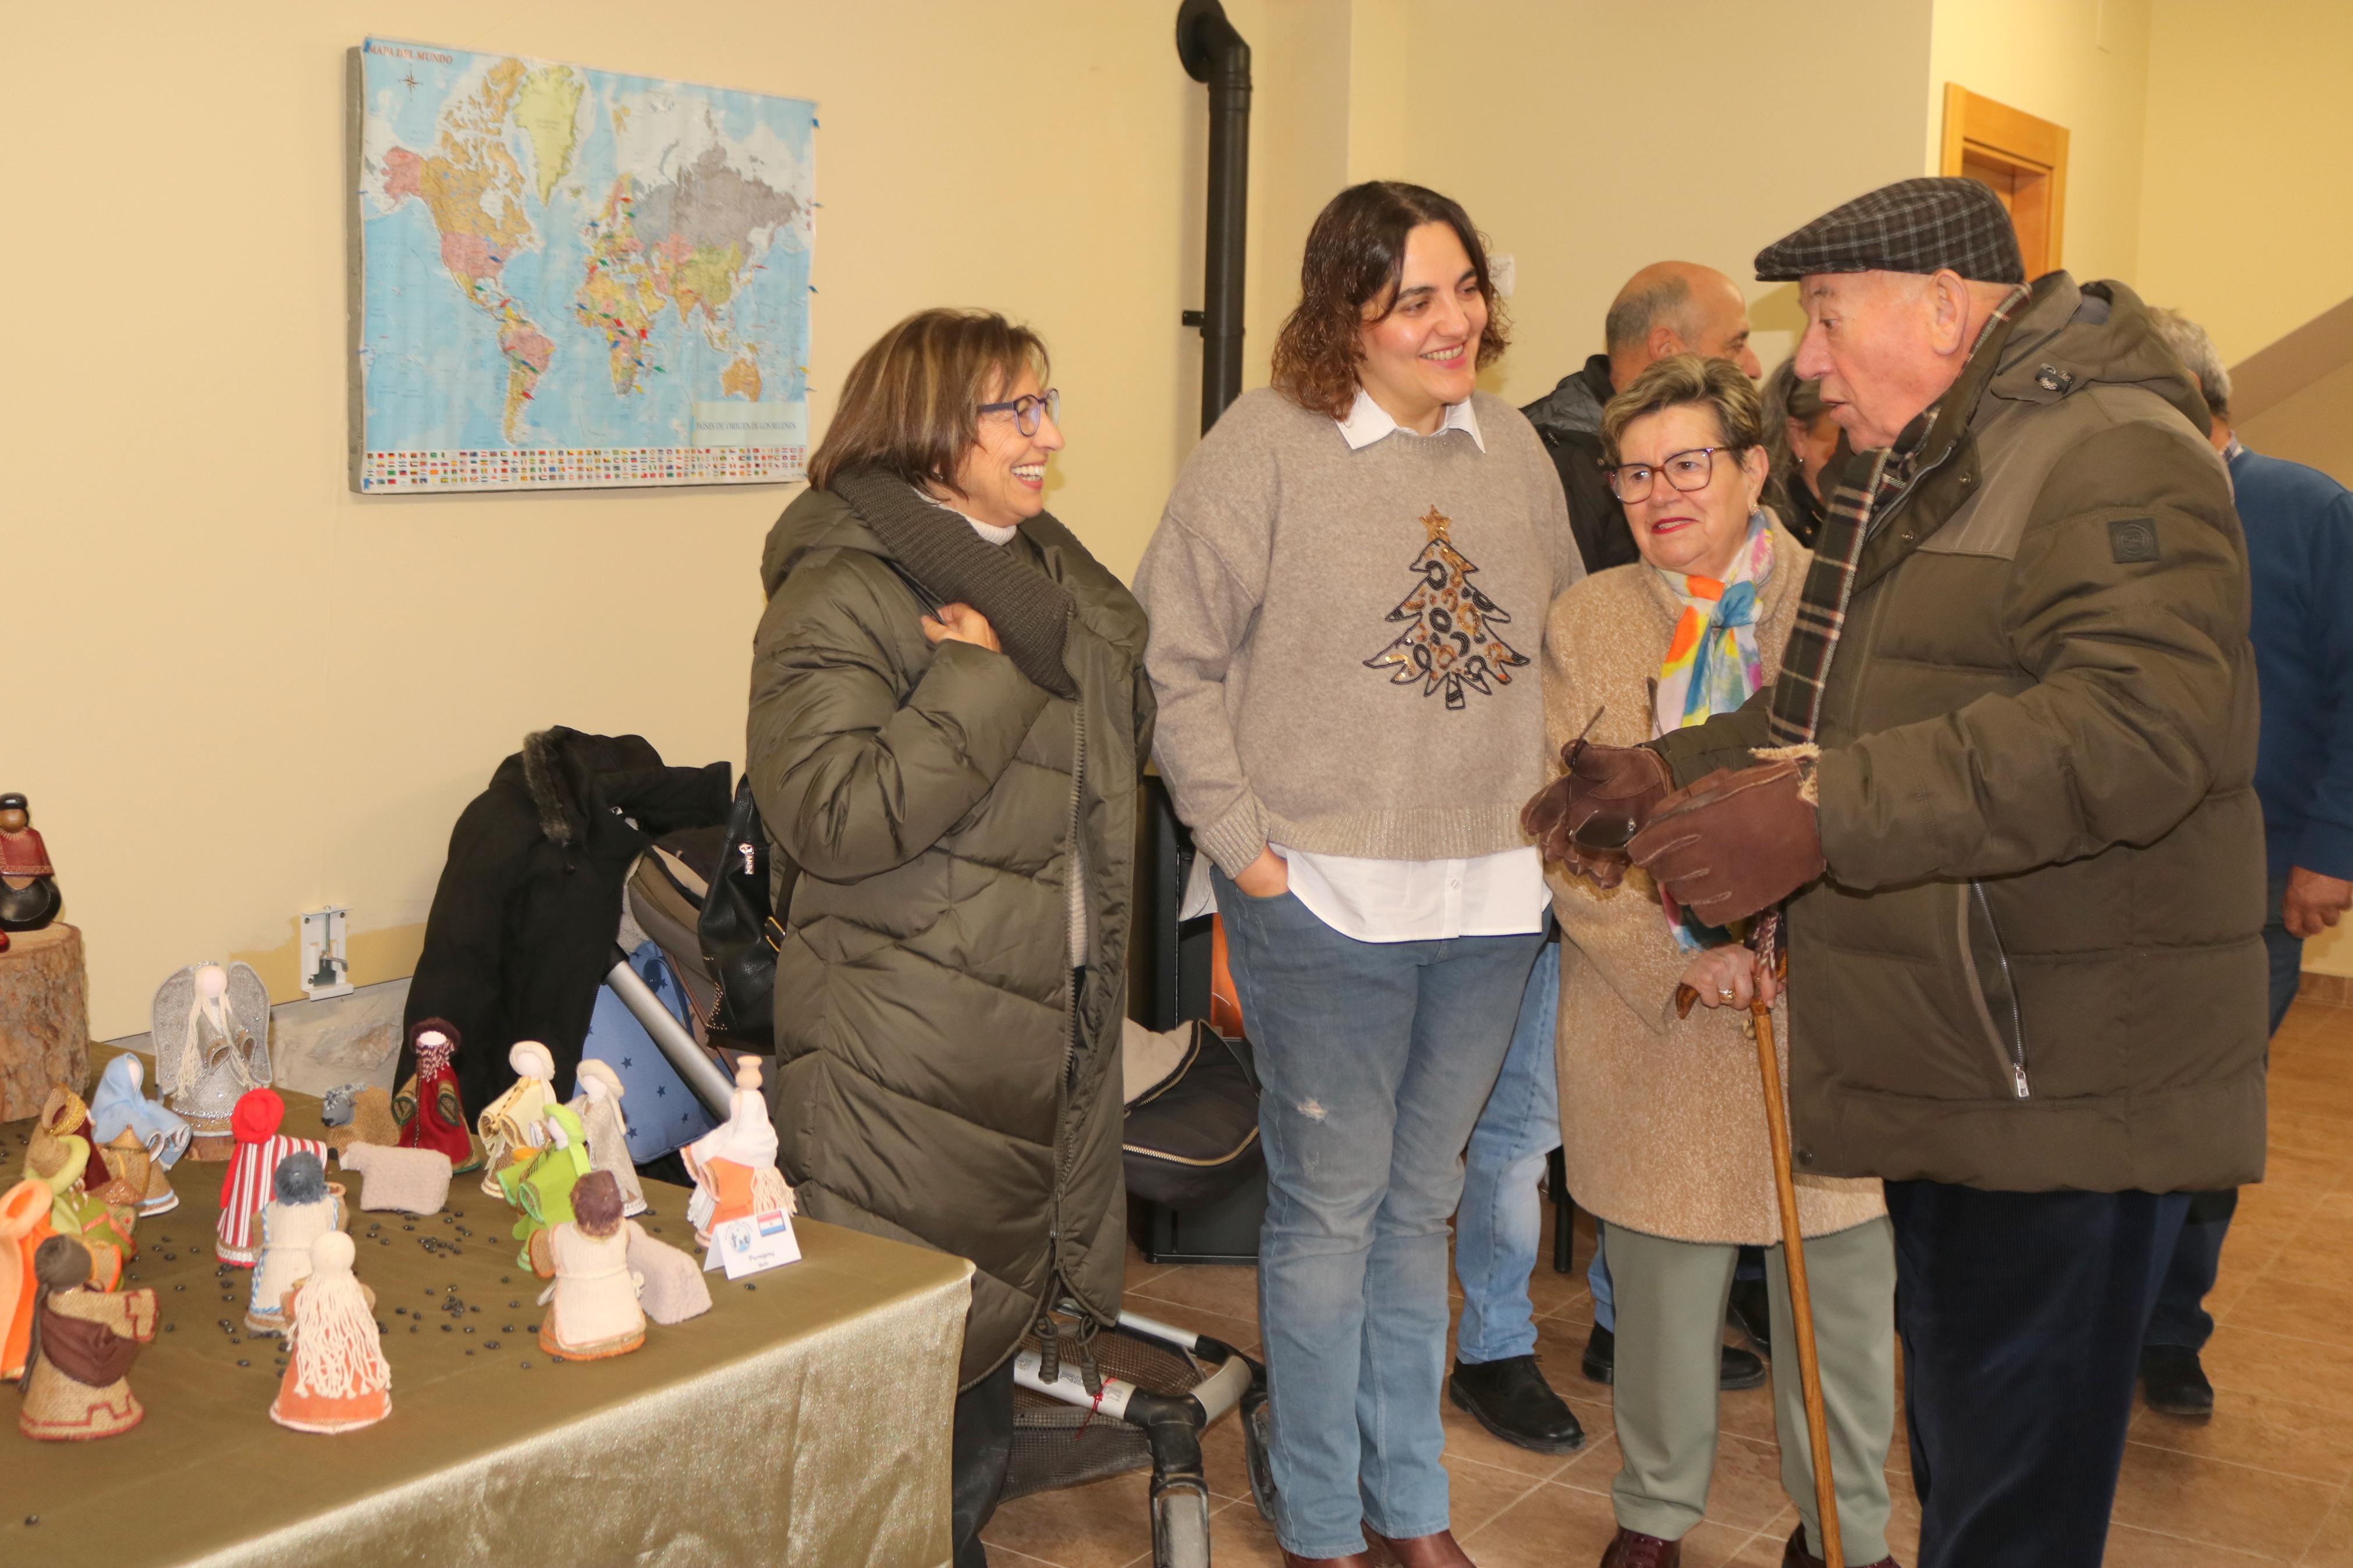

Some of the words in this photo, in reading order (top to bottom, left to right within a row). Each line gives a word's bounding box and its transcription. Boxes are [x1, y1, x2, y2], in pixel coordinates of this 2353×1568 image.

[369, 45, 393, 56] MAPA
[396, 48, 414, 59] DEL
[416, 51, 453, 65] MUNDO
[716, 422, 724, 430] DE
[726, 422, 750, 430] ORIGEN
[751, 422, 758, 430] DE
[760, 422, 771, 430] LOS
[772, 421, 797, 430] BELENES
